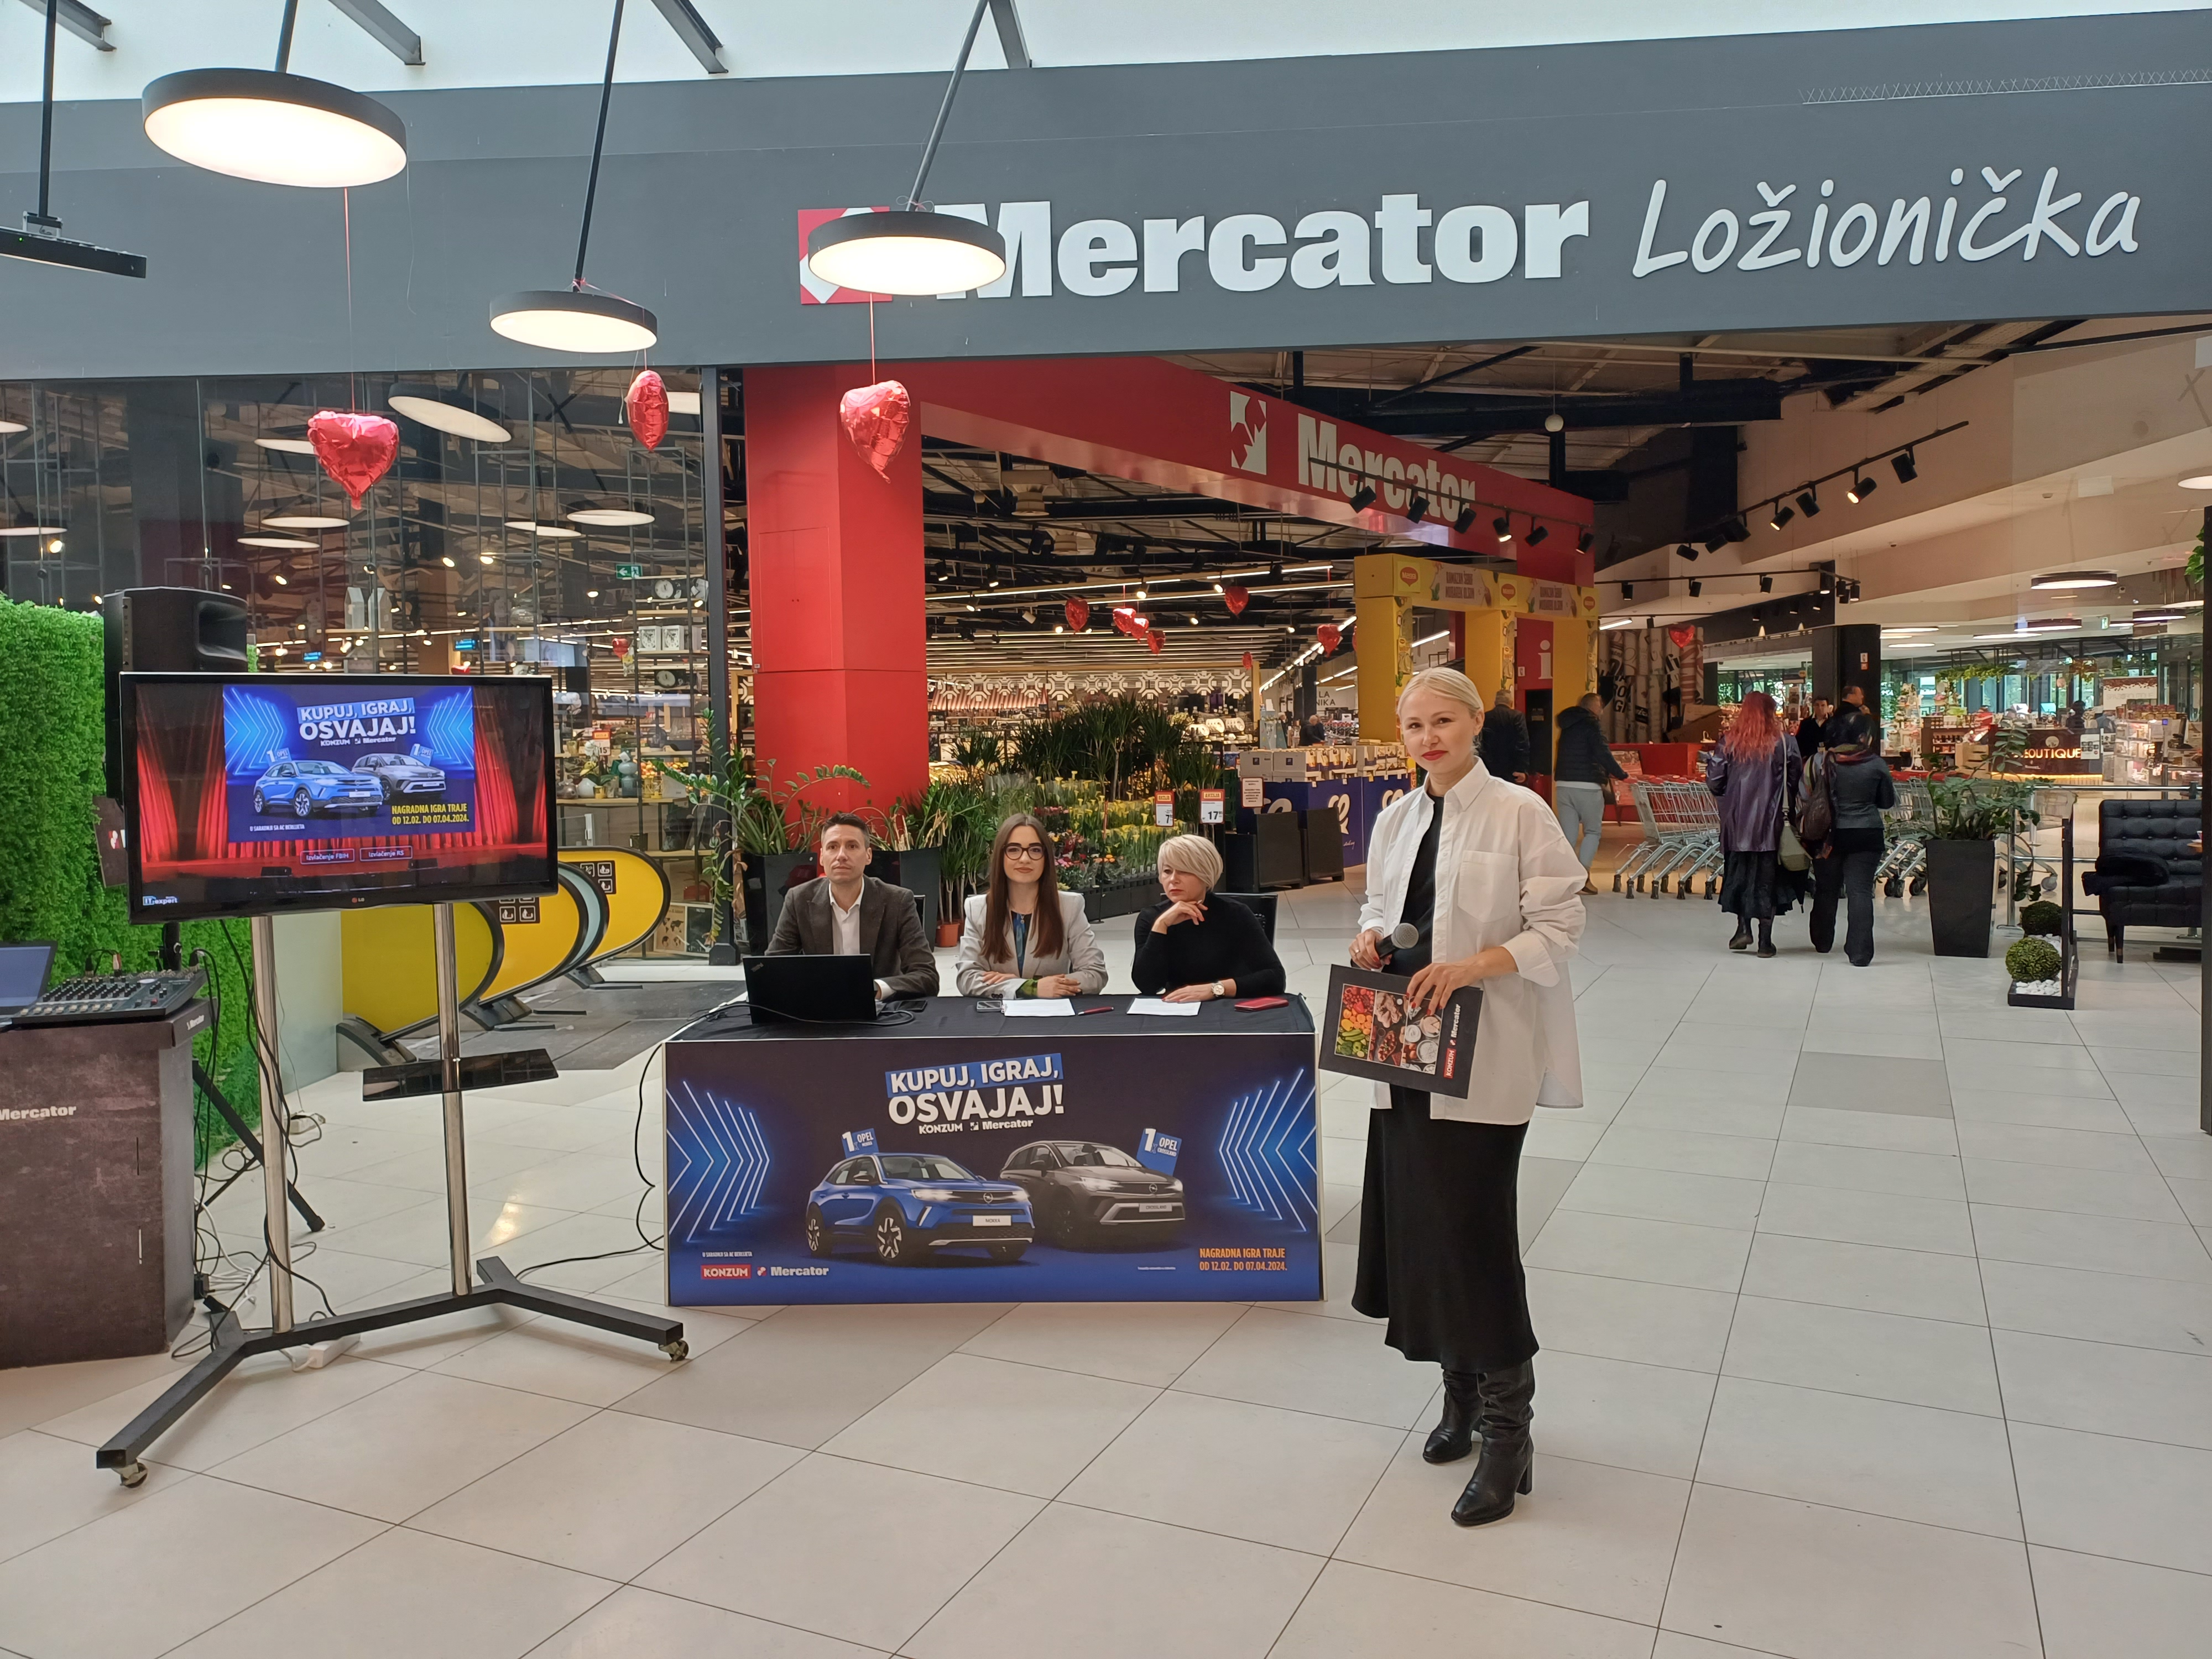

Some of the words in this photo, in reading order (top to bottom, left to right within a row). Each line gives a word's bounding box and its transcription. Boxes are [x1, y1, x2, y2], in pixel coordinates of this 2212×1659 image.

[935, 194, 1589, 299] Mercator
[1633, 168, 2140, 278] Ložionička
[1298, 413, 1475, 521] Mercator
[300, 705, 357, 721] KUPUJ,
[361, 700, 413, 716] IGRAJ,
[299, 716, 416, 740] OSVAJAJ!
[392, 805, 429, 815] NAGRADNA
[430, 805, 446, 813] IGRA
[447, 804, 468, 812] TRAJE
[392, 816, 402, 825] OD
[403, 816, 421, 825] 12.02.
[422, 815, 431, 824] DO
[433, 814, 469, 823] 07.04.2024.
[1446, 1050, 1455, 1077] KONZUM
[1451, 1004, 1460, 1038] Mercator
[891, 1065, 975, 1093] KUPUJ,
[980, 1056, 1058, 1084] IGRAJ,
[888, 1084, 1065, 1124] OSVAJAJ!
[0, 1105, 77, 1121] Mercator
[919, 1123, 963, 1134] KONZUM
[982, 1119, 1034, 1130] Mercator
[857, 1131, 874, 1143] OPEL
[1159, 1137, 1177, 1151] OPEL
[1199, 1248, 1241, 1258] NAGRADNA
[1243, 1248, 1261, 1258] IGRA
[1262, 1248, 1286, 1258] TRAJE
[703, 1267, 748, 1277] KONZUM
[770, 1266, 829, 1276] Mercator
[1199, 1261, 1210, 1271] OD
[1212, 1261, 1232, 1270] 12.02.
[1234, 1261, 1244, 1270] DO
[1245, 1261, 1287, 1271] 07.04.2024.
